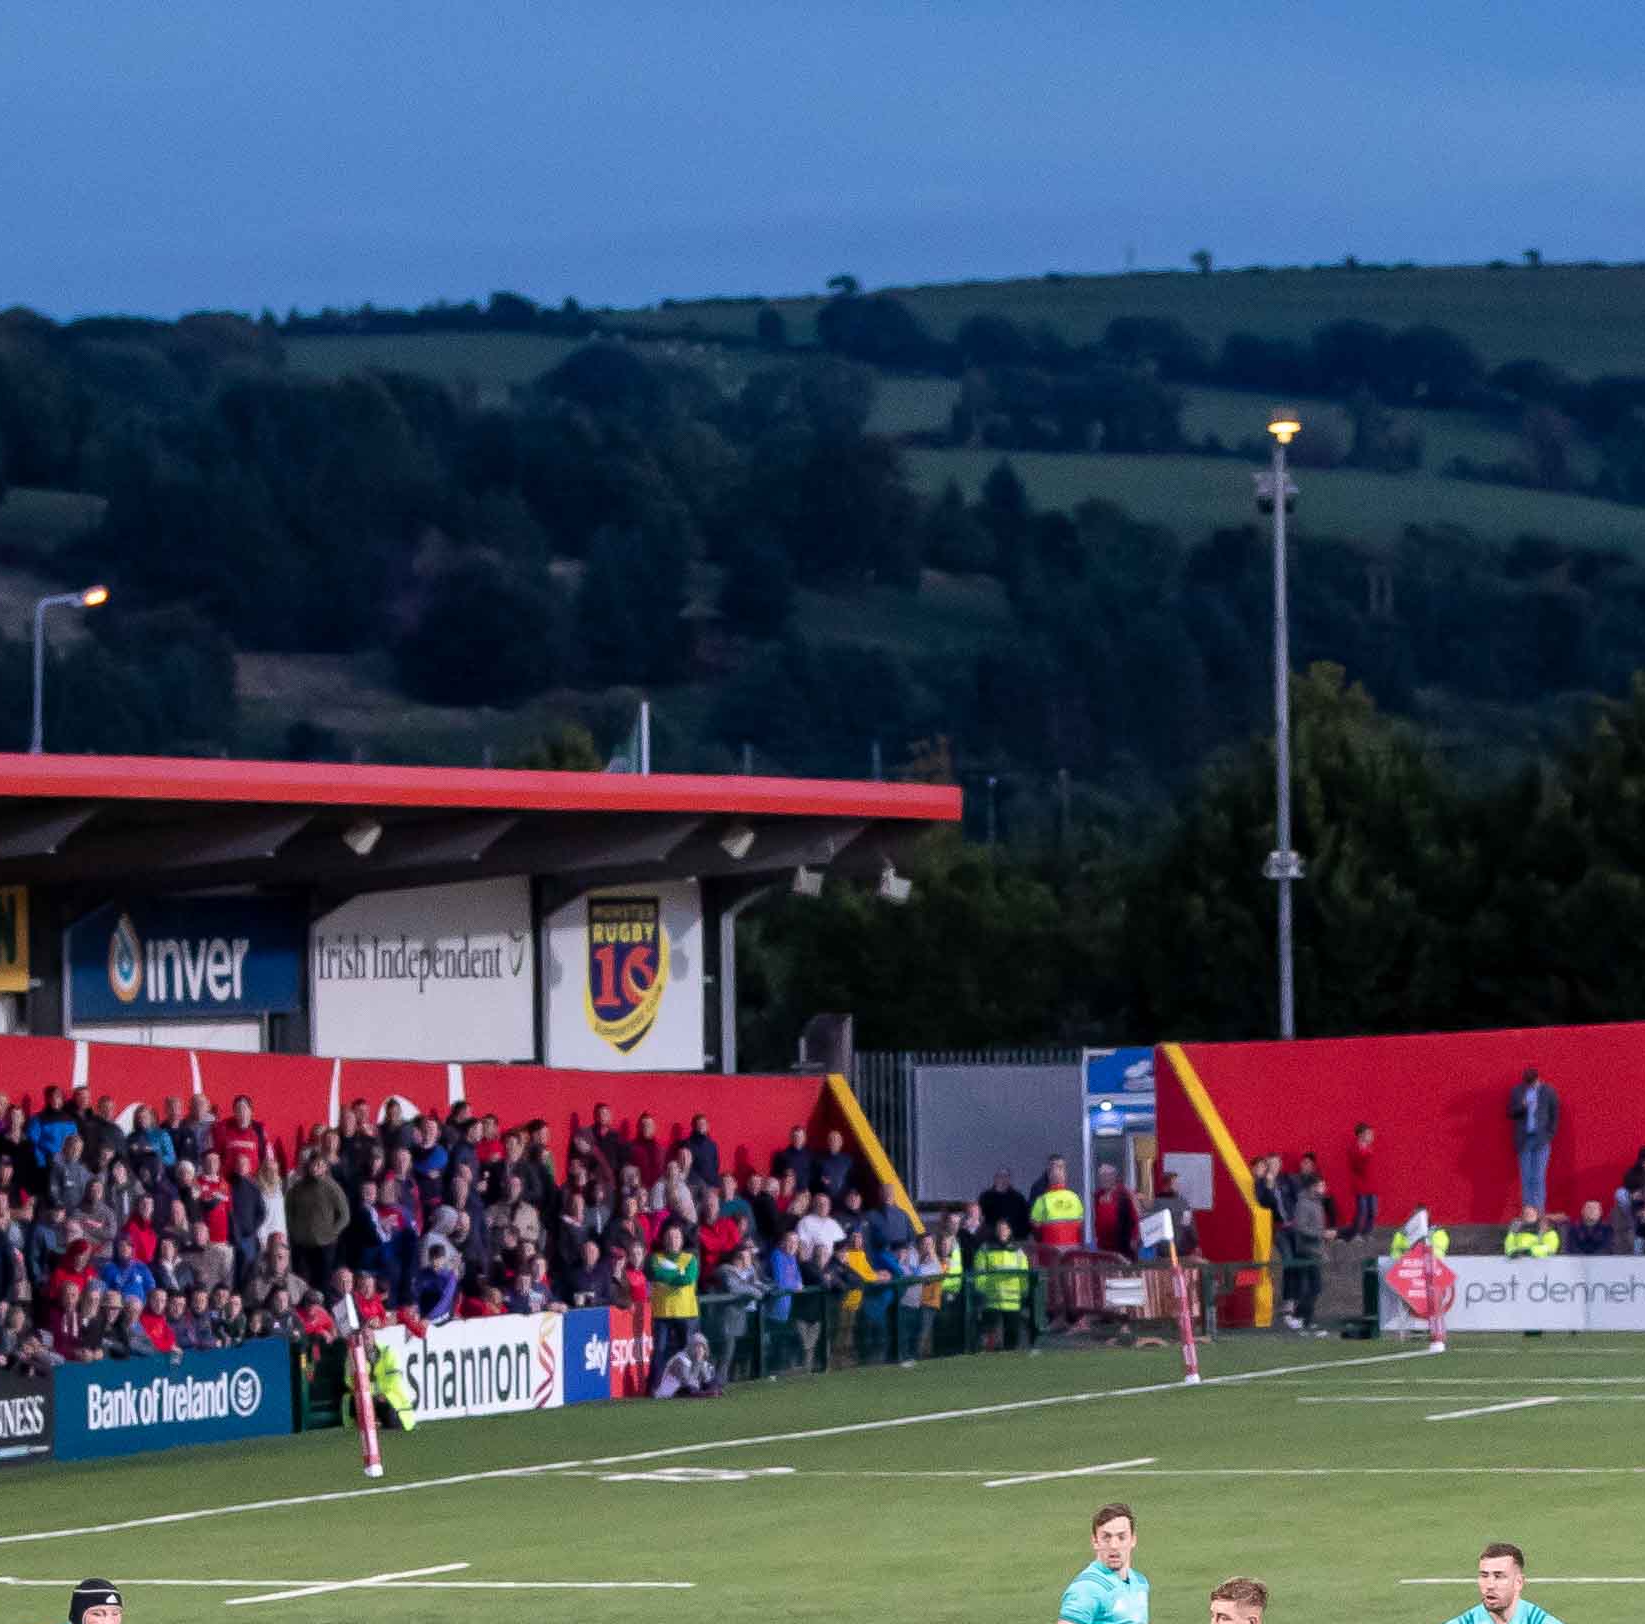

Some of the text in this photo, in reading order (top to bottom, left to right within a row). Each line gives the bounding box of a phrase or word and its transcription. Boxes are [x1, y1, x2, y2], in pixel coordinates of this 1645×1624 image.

[593, 923, 655, 943] RUGBY
[145, 938, 249, 1001] inver
[317, 935, 503, 993] Irish Independent
[593, 945, 657, 1007] 16
[1464, 1275, 1521, 1308] pat
[406, 1335, 531, 1412] shannon
[585, 1332, 611, 1377] sky
[88, 1370, 230, 1430] Bank of Ireland
